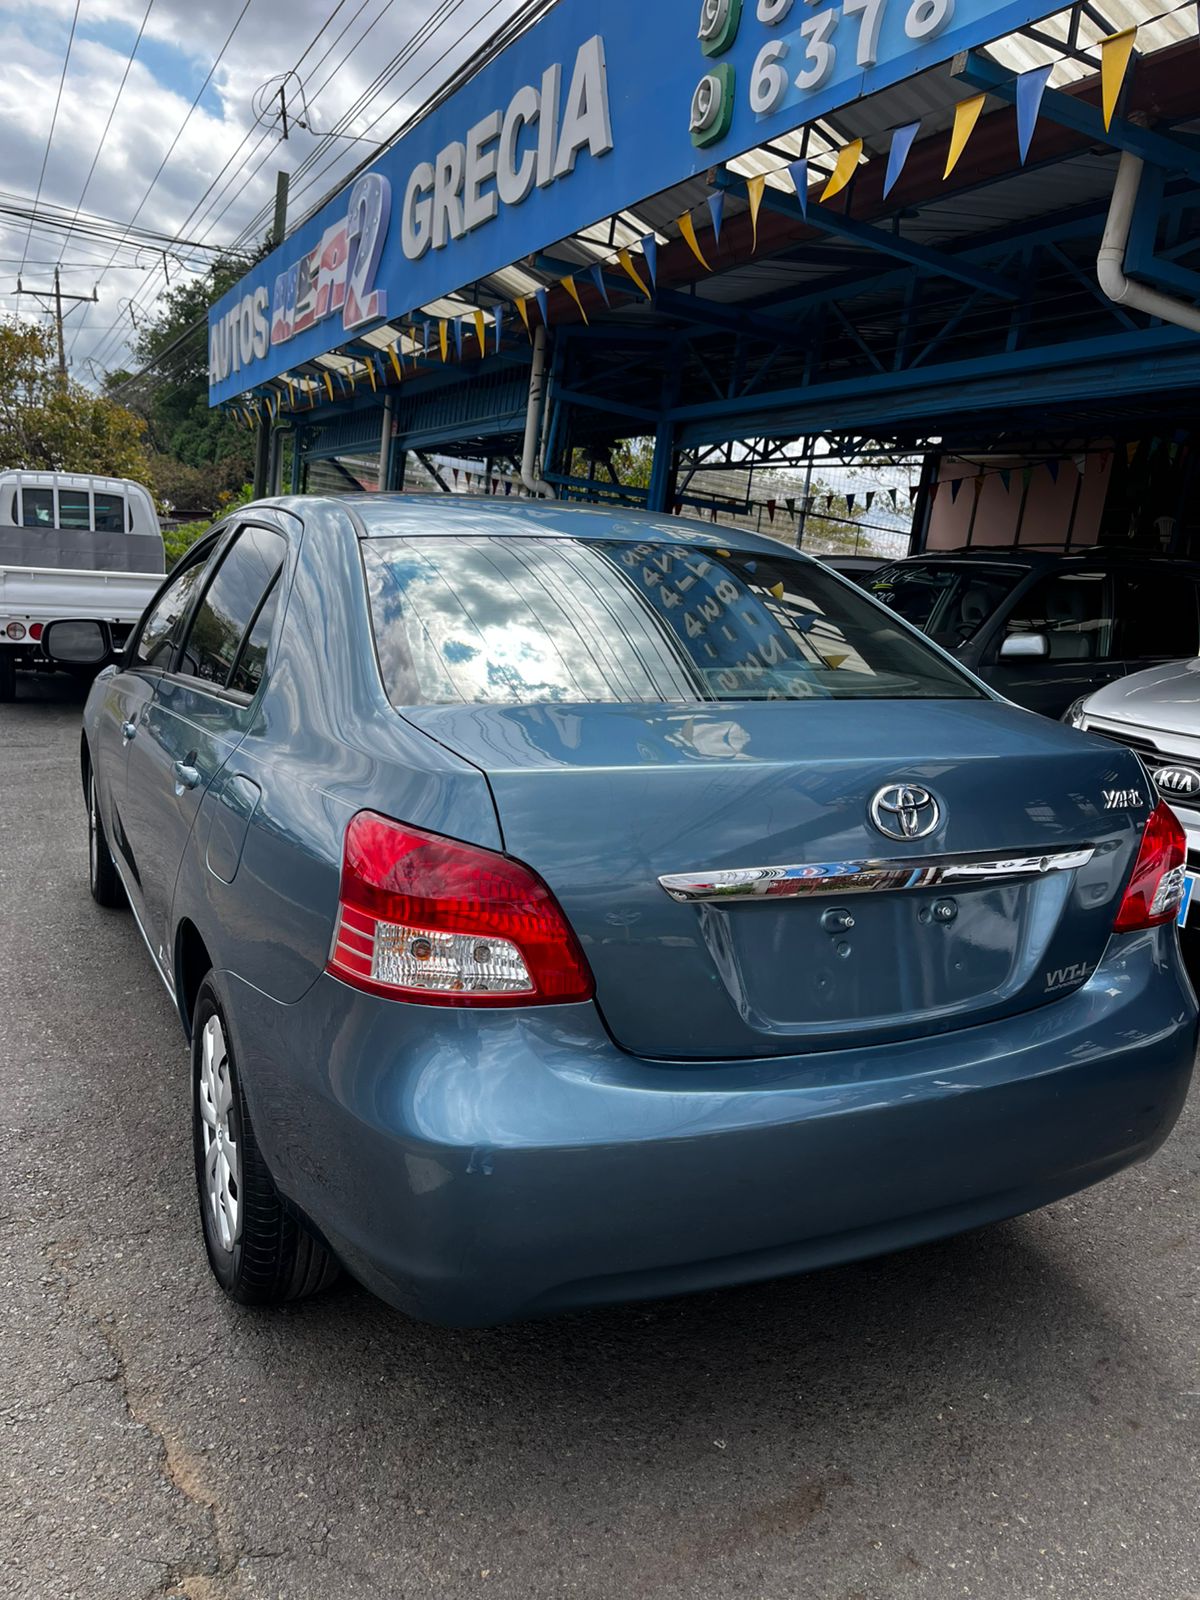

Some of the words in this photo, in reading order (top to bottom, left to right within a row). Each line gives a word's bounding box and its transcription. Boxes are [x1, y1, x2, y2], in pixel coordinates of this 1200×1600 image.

[208, 286, 270, 387] AUTOS
[342, 172, 392, 331] 2
[401, 34, 614, 261] GRECIA
[1158, 770, 1192, 792] KIA
